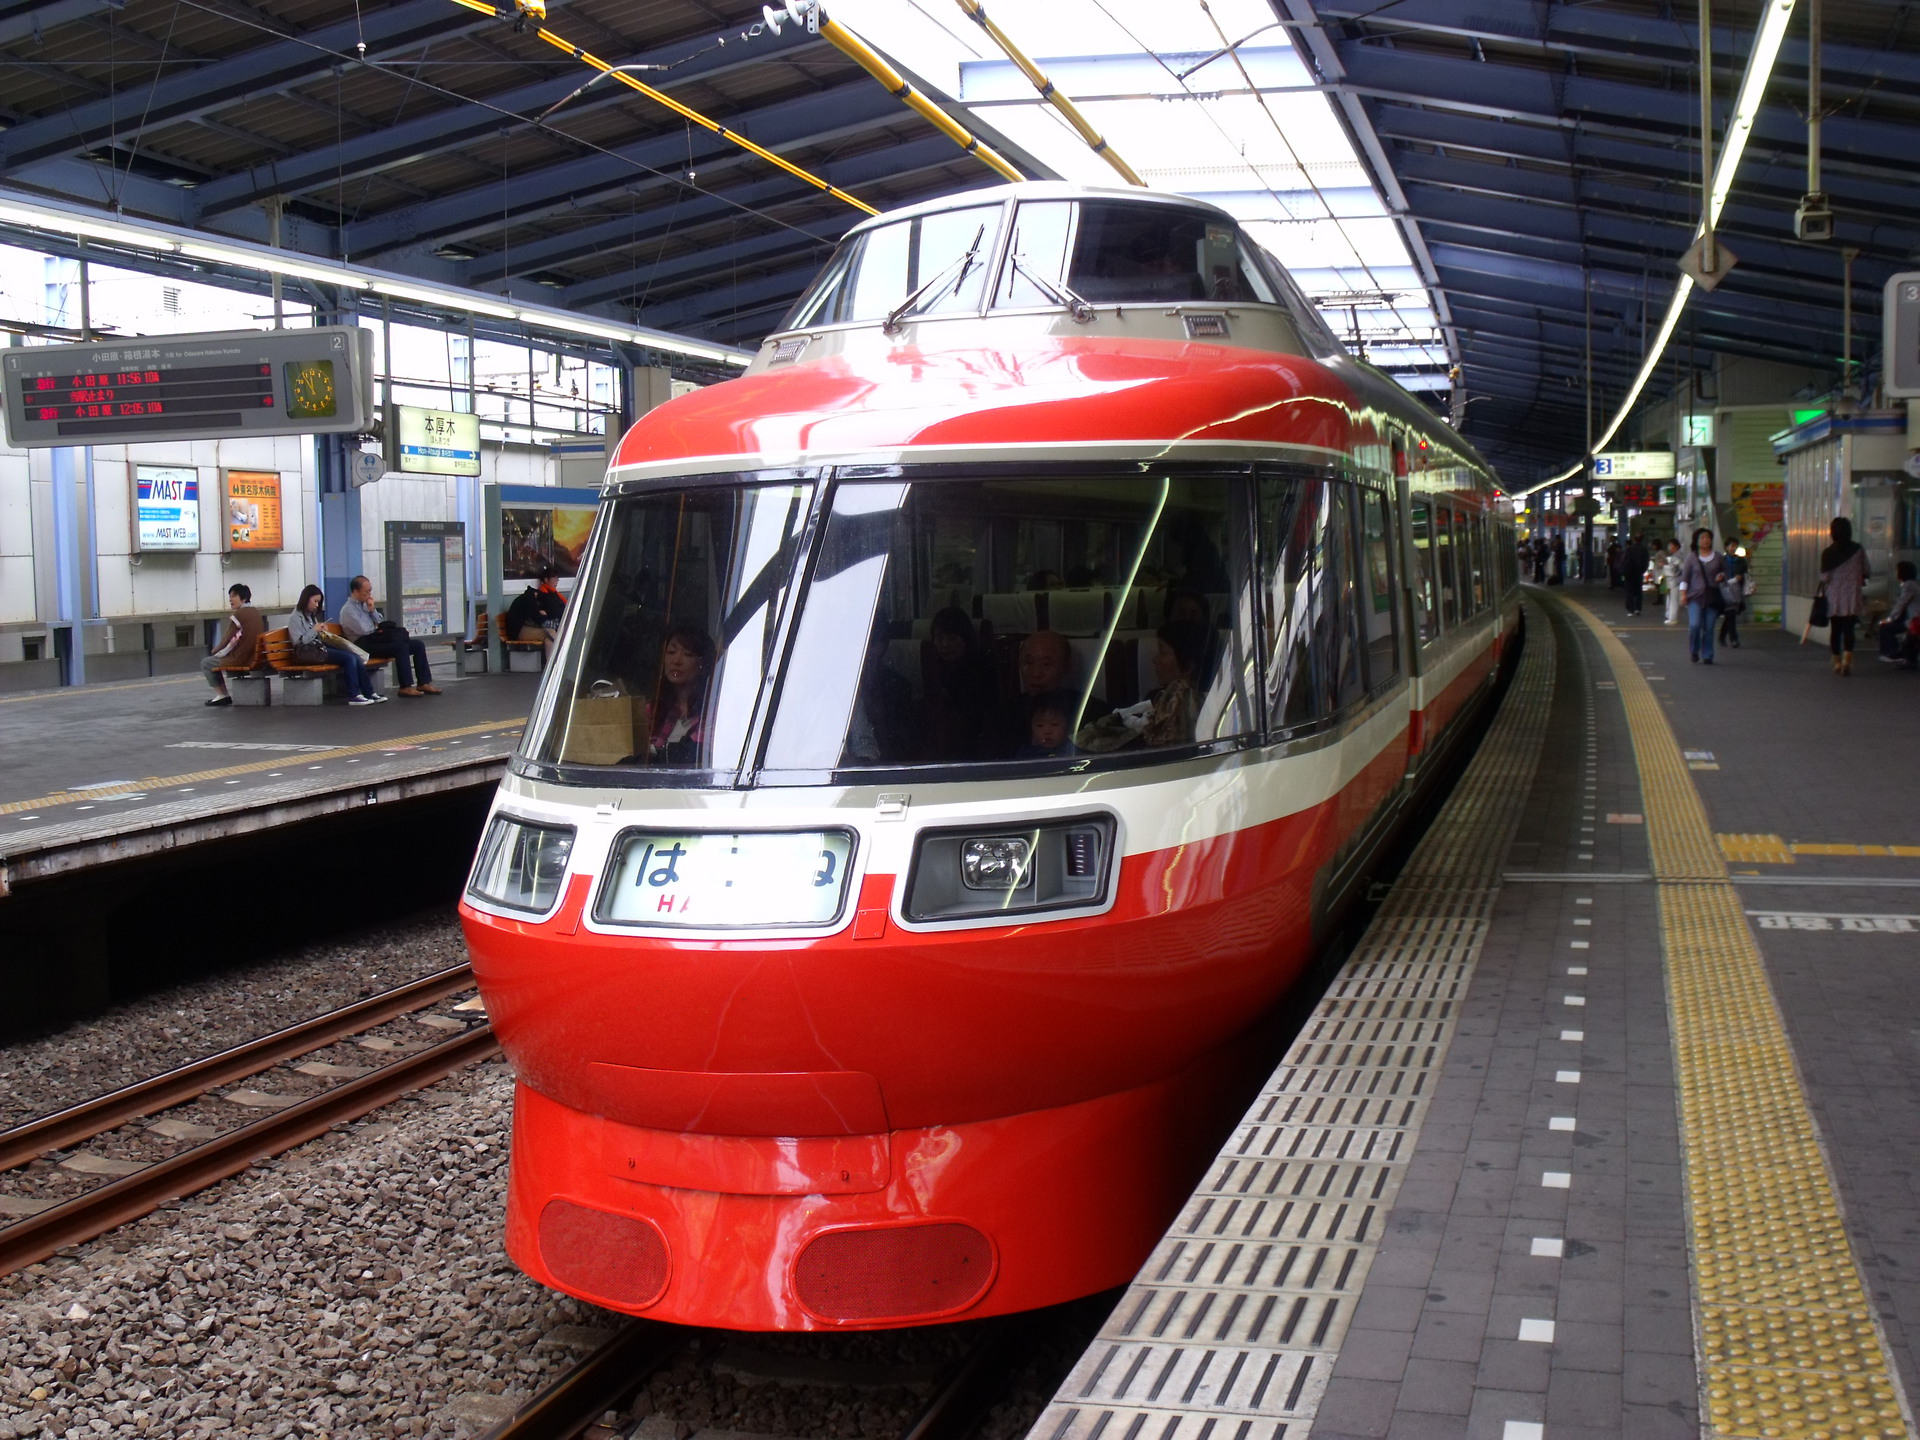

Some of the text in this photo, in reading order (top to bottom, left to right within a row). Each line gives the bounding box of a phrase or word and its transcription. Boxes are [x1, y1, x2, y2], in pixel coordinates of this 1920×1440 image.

[1907, 286, 1918, 300] 3
[333, 337, 342, 349] 2
[72, 374, 109, 388] 小田原
[117, 371, 141, 385] 11:56
[75, 403, 113, 418] 小田原
[120, 403, 144, 415] 12:05
[424, 415, 456, 437] 本厚木
[1599, 459, 1610, 474] 3
[152, 479, 183, 500] MAST
